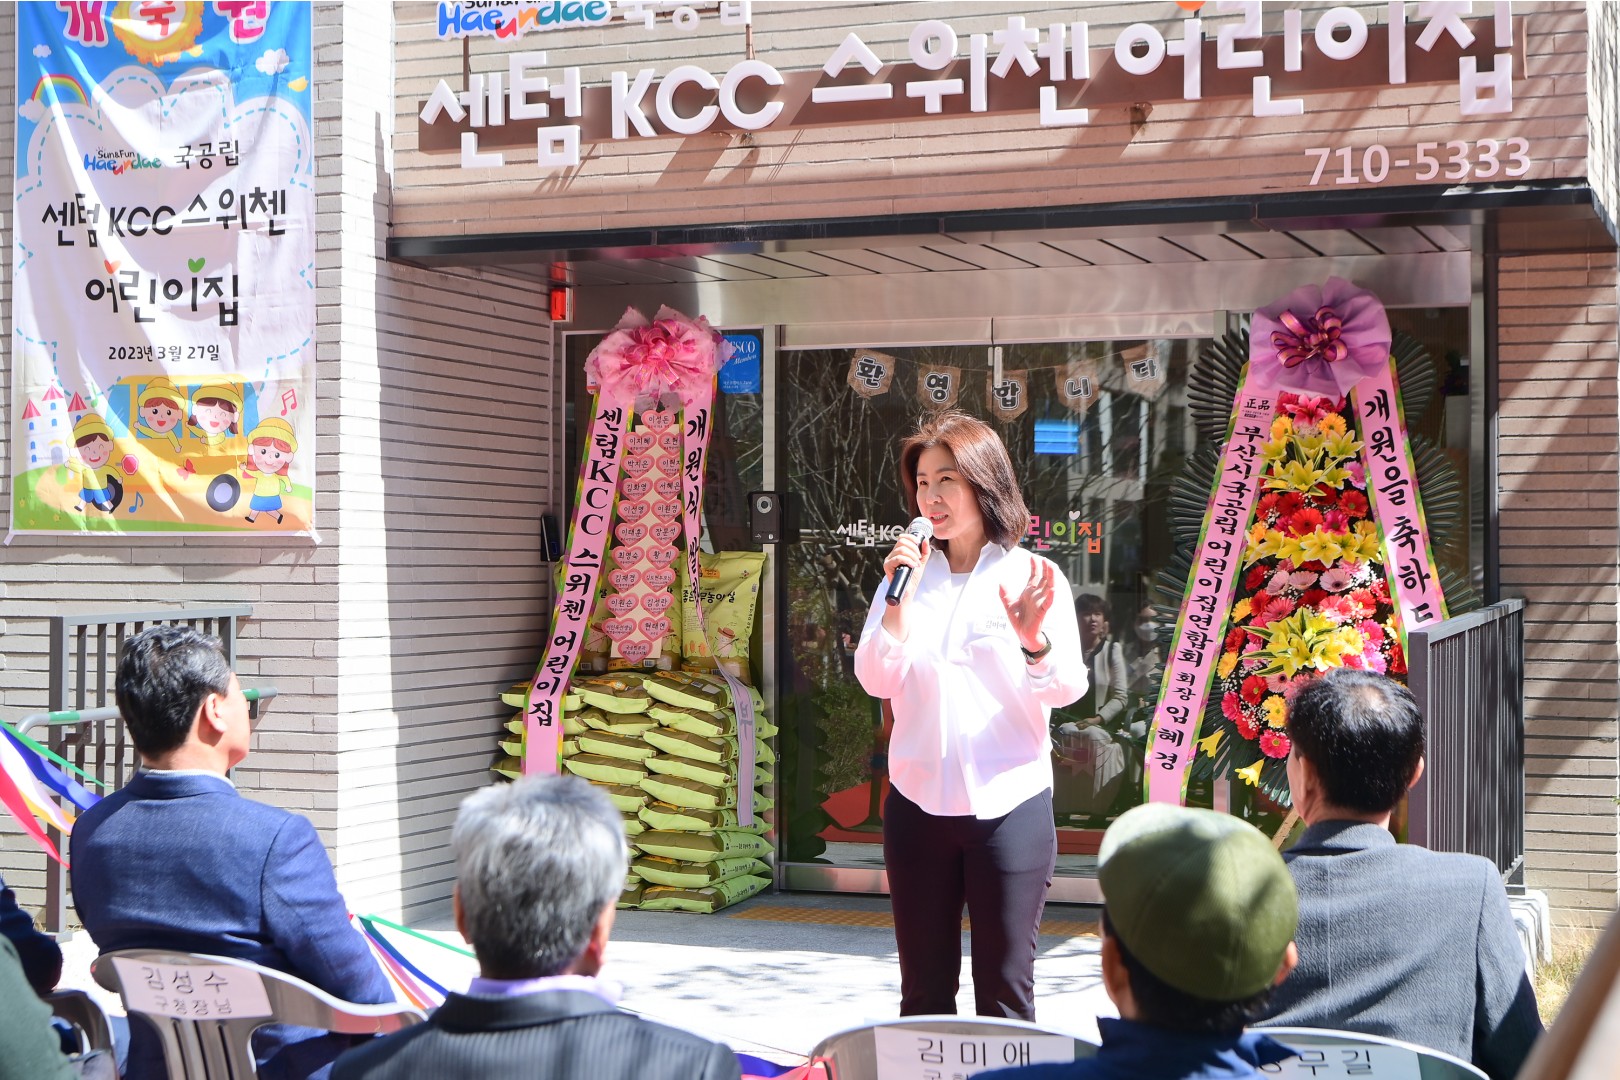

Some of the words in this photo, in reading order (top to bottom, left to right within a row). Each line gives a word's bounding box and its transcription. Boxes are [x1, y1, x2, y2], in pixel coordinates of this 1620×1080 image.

[438, 1, 607, 38] Haeundae
[419, 51, 582, 168] 센텀
[610, 59, 785, 139] KCC
[811, 16, 1091, 126] 스위첸
[1114, 0, 1513, 117] 어린이집
[83, 152, 162, 175] Haeundae
[174, 140, 239, 169] 국공립
[97, 148, 135, 159] Sun&Fun
[1304, 137, 1531, 186] 710-5333
[42, 193, 100, 248] 센텀
[107, 205, 176, 238] KCC
[181, 187, 286, 236] 스위첸
[85, 270, 239, 326] 어린이집
[108, 345, 154, 362] 2023년
[157, 345, 182, 362] 3월
[187, 344, 220, 361] 27일
[855, 356, 1158, 411] 환영합니다
[1244, 398, 1271, 411] 正品
[685, 408, 708, 521] 개원식
[1364, 389, 1409, 506] 개원을
[836, 519, 875, 547] 센텀
[1020, 515, 1103, 554] 린이집
[561, 548, 600, 621] 스위첸
[528, 630, 577, 727] 어린이집
[1155, 705, 1190, 771] 임혜경
[142, 966, 228, 994] 김성수
[917, 1037, 1030, 1067] 김미애
